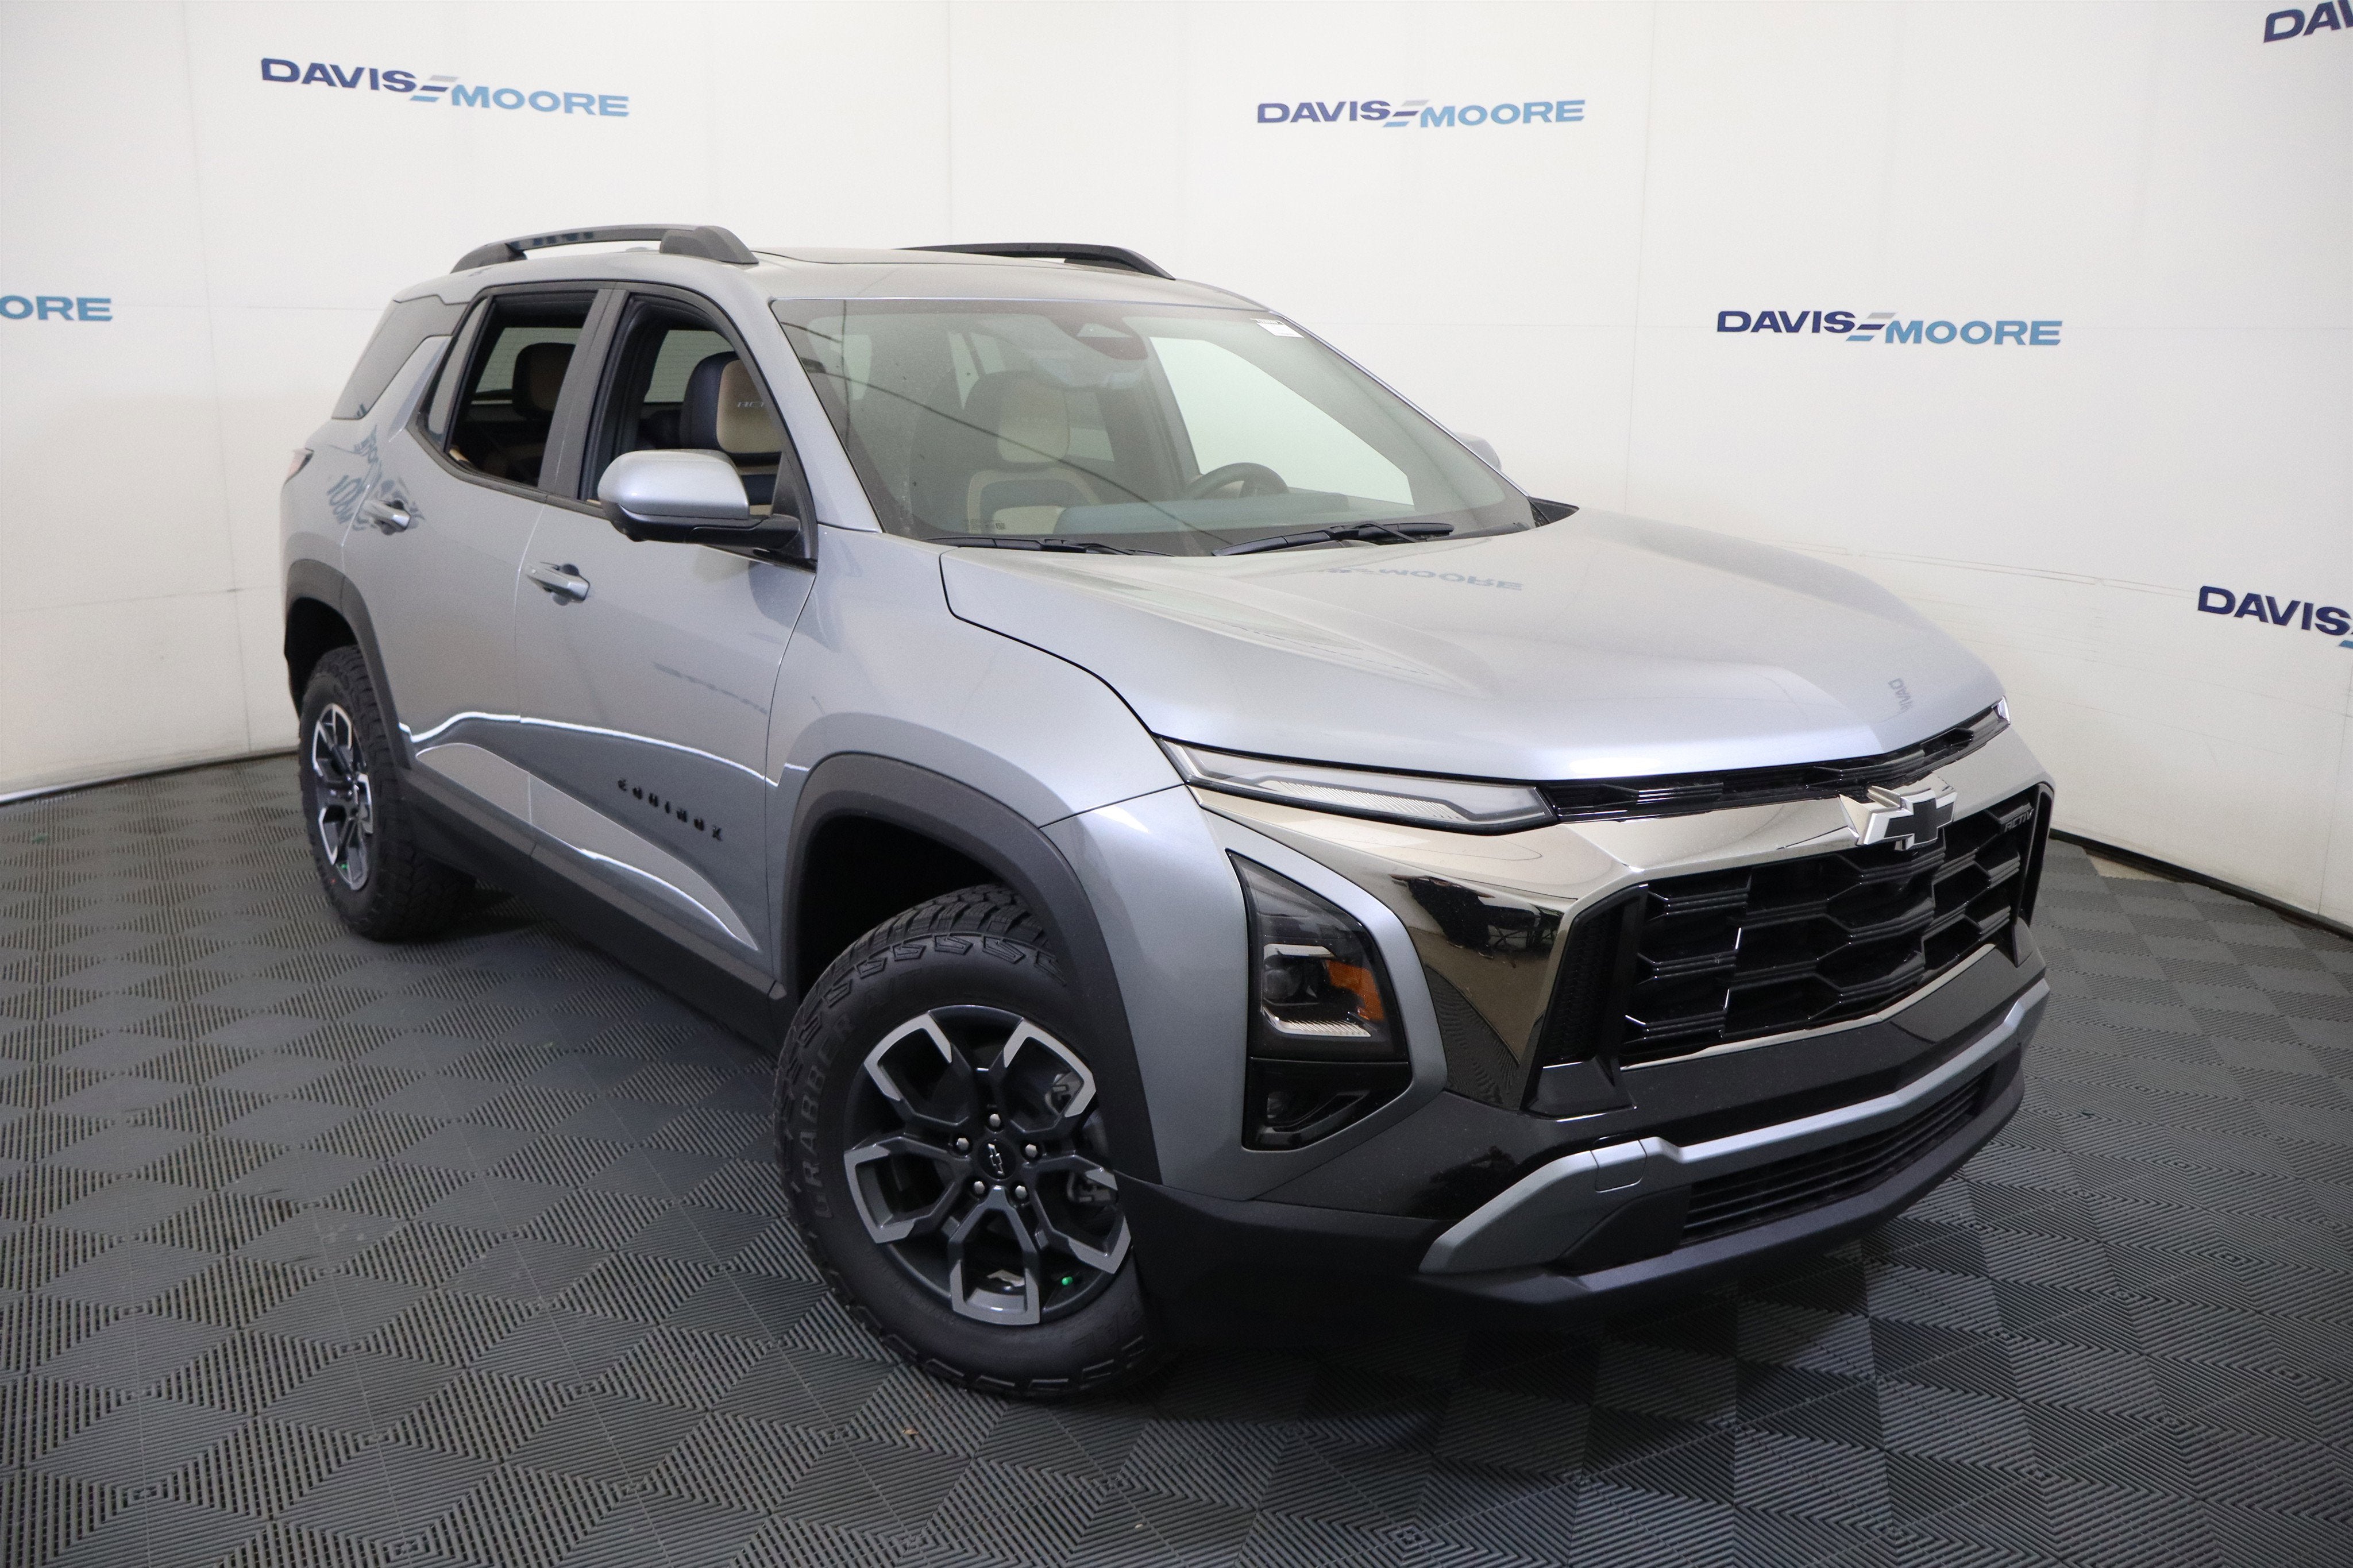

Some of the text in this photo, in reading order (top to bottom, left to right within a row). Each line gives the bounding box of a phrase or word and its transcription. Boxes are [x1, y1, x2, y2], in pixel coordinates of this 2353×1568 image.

[260, 57, 629, 117] DAVIS MOORE
[1257, 99, 1586, 128] DAVIS MOORE
[1716, 310, 2063, 346] DAVIS MOORE
[2197, 585, 2352, 637] DAVIS
[799, 1013, 854, 1219] GRABBER
